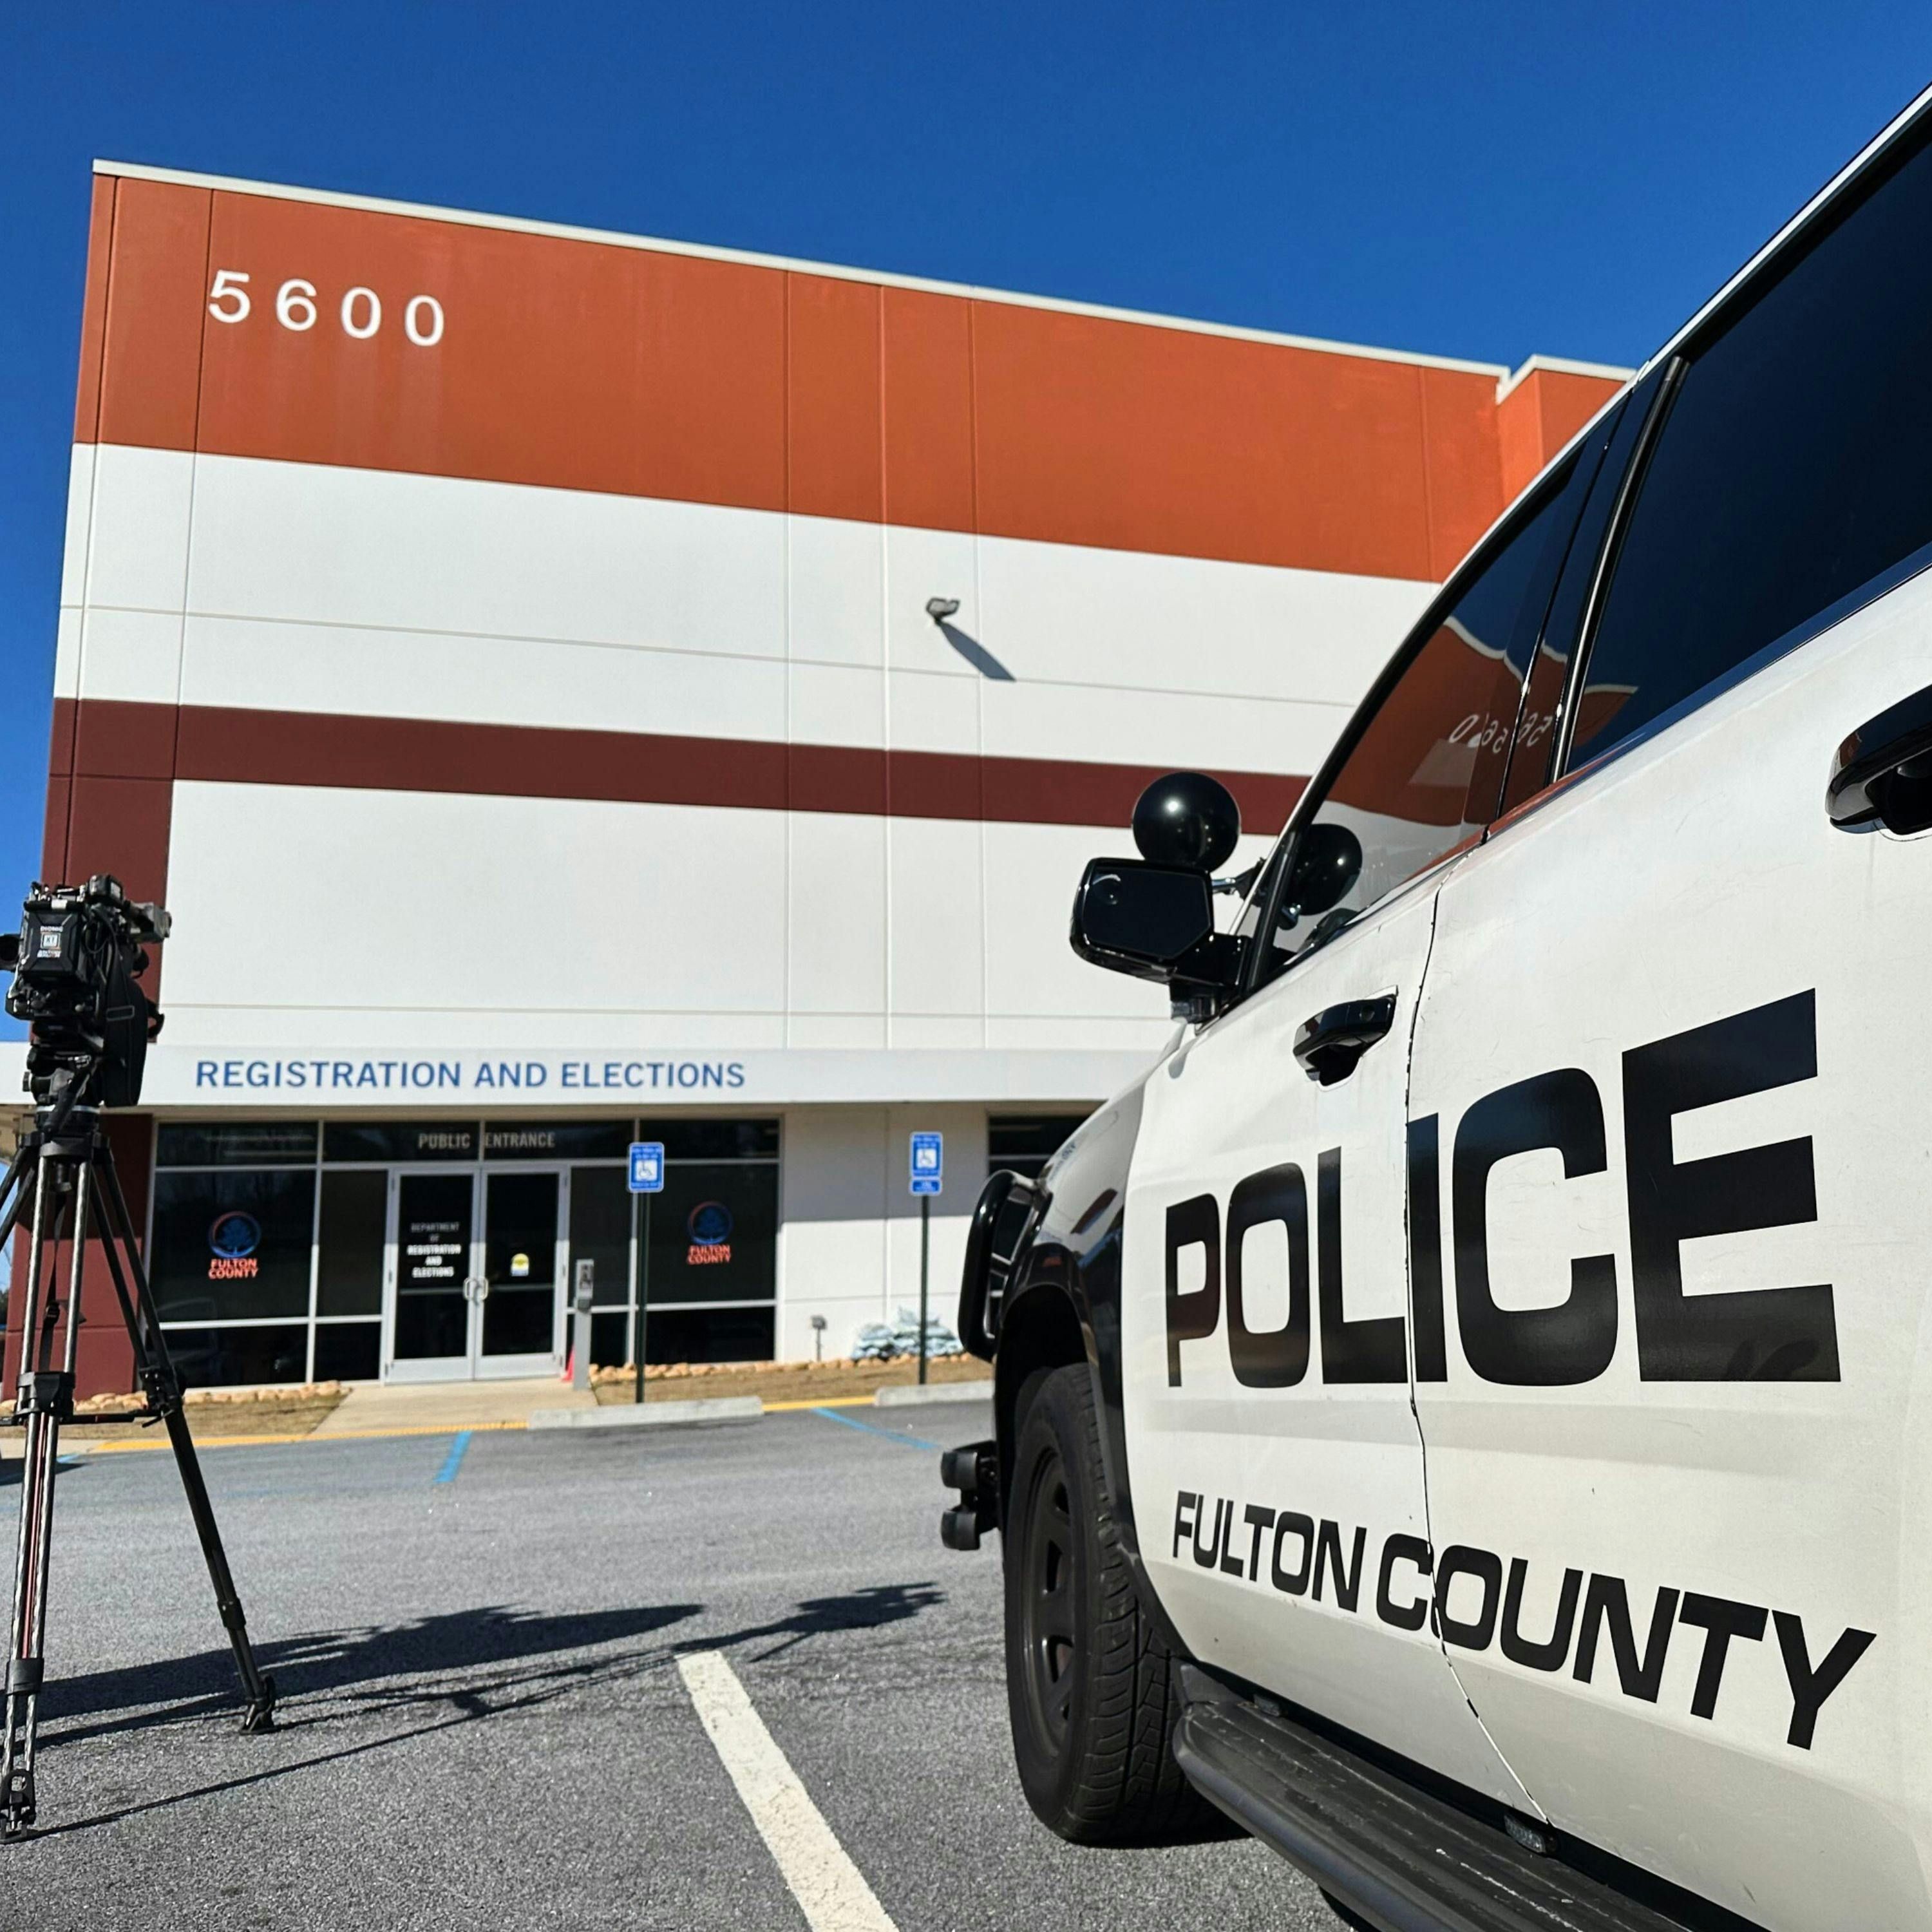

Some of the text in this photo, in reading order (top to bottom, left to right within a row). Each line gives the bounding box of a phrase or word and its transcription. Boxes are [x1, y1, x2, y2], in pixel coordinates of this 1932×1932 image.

[207, 269, 445, 347] 5600
[196, 1060, 745, 1088] REGISTRATION AND ELECTIONS
[419, 1132, 555, 1149] PUBLIC ENTRANCE
[1166, 988, 1841, 1388] POLICE
[688, 1244, 731, 1255] FULTON
[211, 1258, 258, 1269] FULTON
[687, 1254, 731, 1265] COUNTY
[208, 1267, 258, 1280] COUNTY
[1172, 1490, 1878, 1751] FULTON COUNTY
